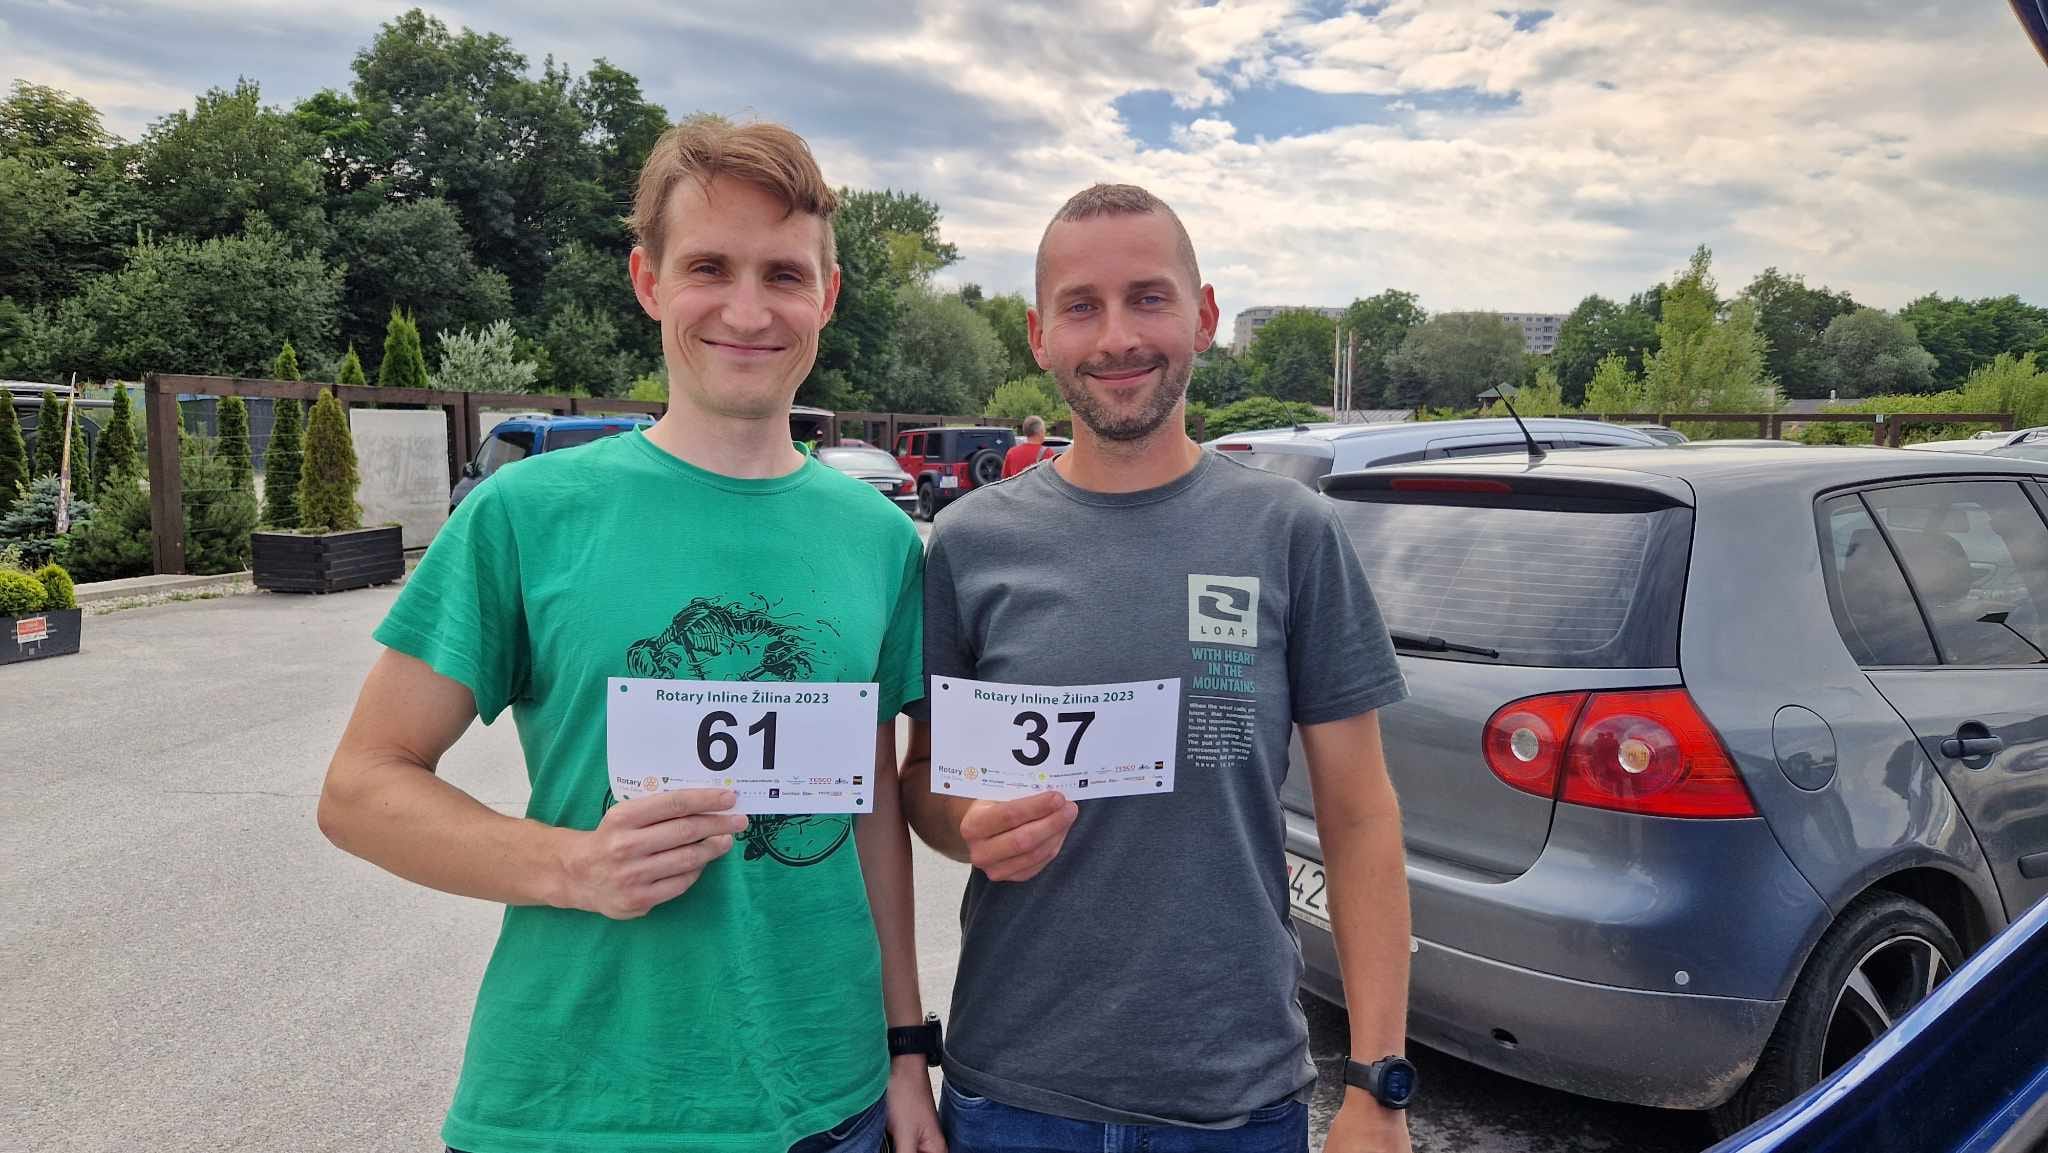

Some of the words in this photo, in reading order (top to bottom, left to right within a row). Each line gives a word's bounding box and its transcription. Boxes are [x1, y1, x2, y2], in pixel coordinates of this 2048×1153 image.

[1201, 625, 1248, 638] LOAP
[1191, 647, 1222, 661] WITH
[1224, 650, 1256, 665] HEART
[1208, 662, 1221, 675] IN
[1223, 664, 1243, 677] THE
[1192, 676, 1256, 693] MOUNTAINS
[656, 689, 703, 705] Rotary
[707, 691, 748, 703] Inline
[751, 690, 791, 704] Žilina
[794, 692, 829, 704] 2023
[974, 688, 1018, 705] Rotary
[1021, 693, 1059, 705] Inline
[1062, 691, 1099, 705] Žilina
[1103, 690, 1134, 703] 2023
[696, 710, 778, 772] 61
[1011, 711, 1096, 766] 37
[939, 765, 963, 775] Rotary
[616, 776, 641, 787] Rotary
[1290, 863, 1328, 910] 42
